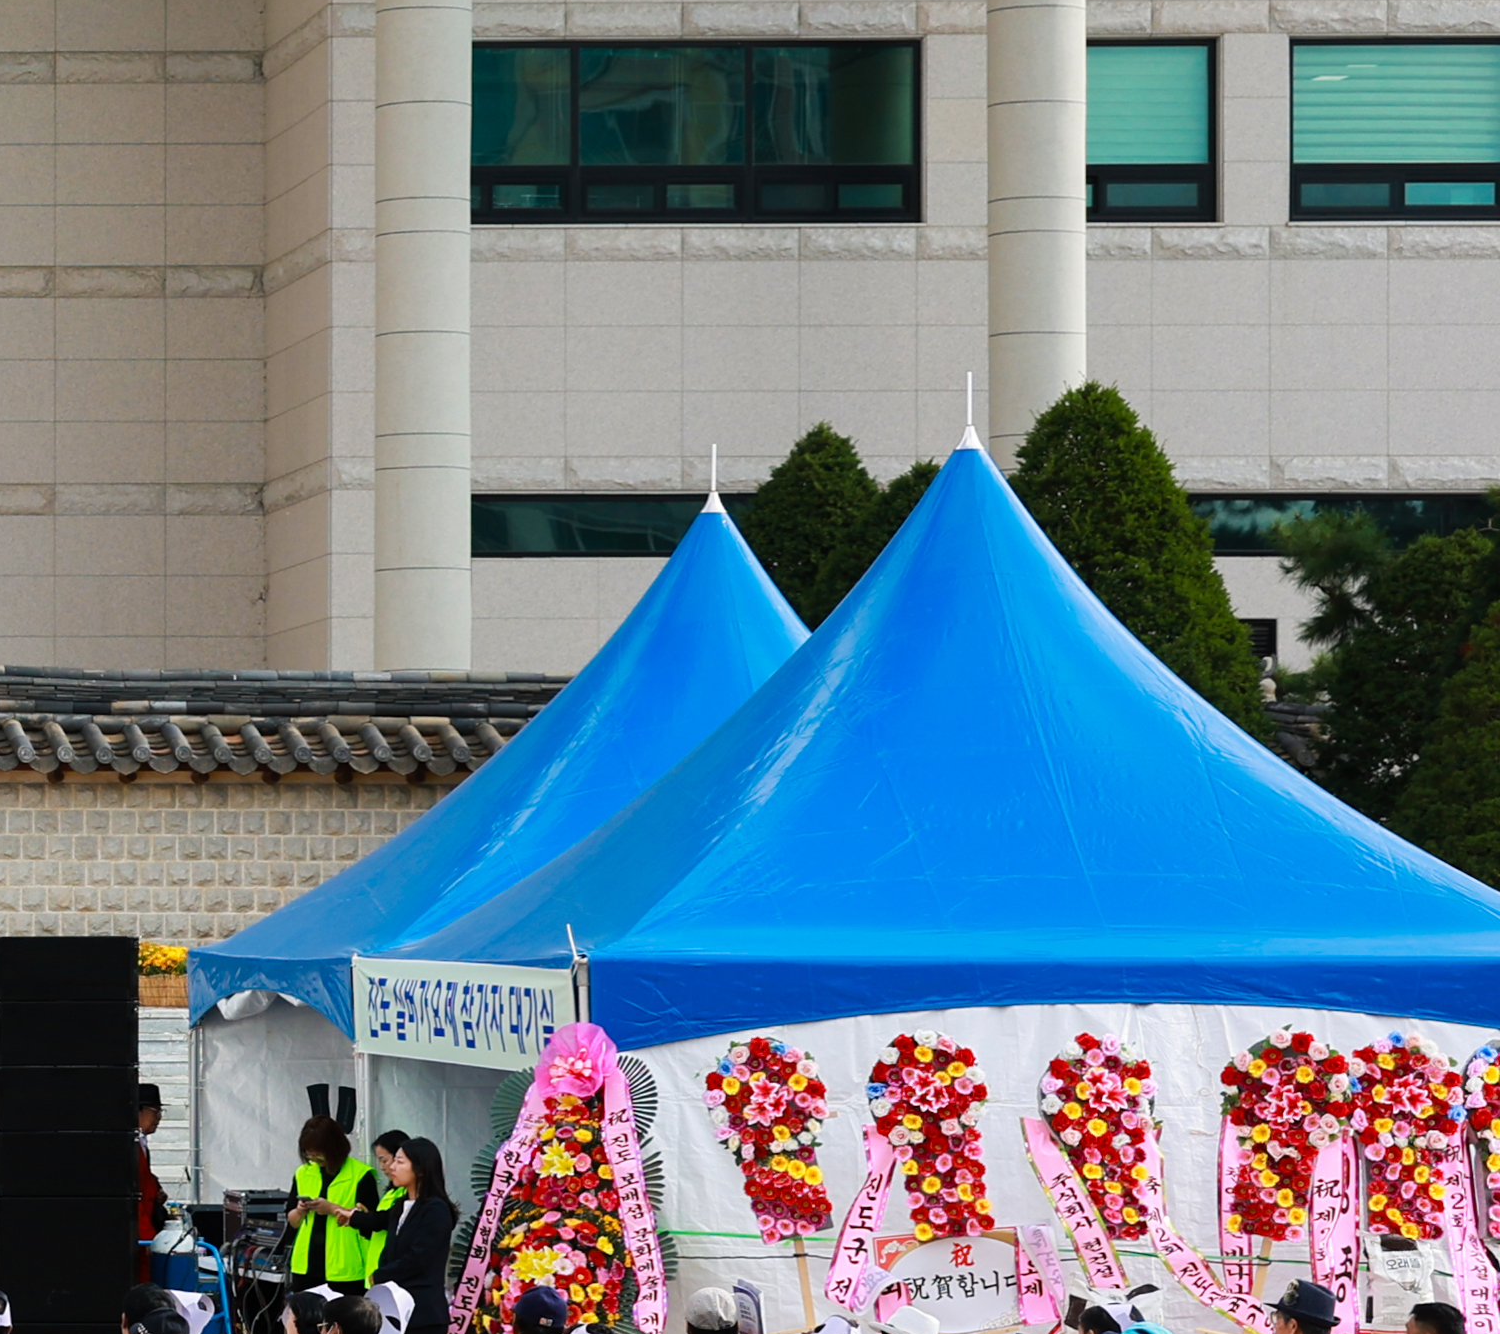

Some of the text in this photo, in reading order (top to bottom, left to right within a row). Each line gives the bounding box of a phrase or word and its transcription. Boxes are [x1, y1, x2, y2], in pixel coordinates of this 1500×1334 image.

[367, 976, 556, 1056] 진도 실버가요제 참가자 대기실
[607, 1107, 630, 1129] 祝
[609, 1132, 637, 1166] 진도
[618, 1173, 646, 1219] 보배섬
[1313, 1178, 1342, 1200] 祝
[1148, 1207, 1185, 1256] 제2회
[631, 1224, 661, 1304] 문화예술제
[948, 1241, 976, 1269] 祝
